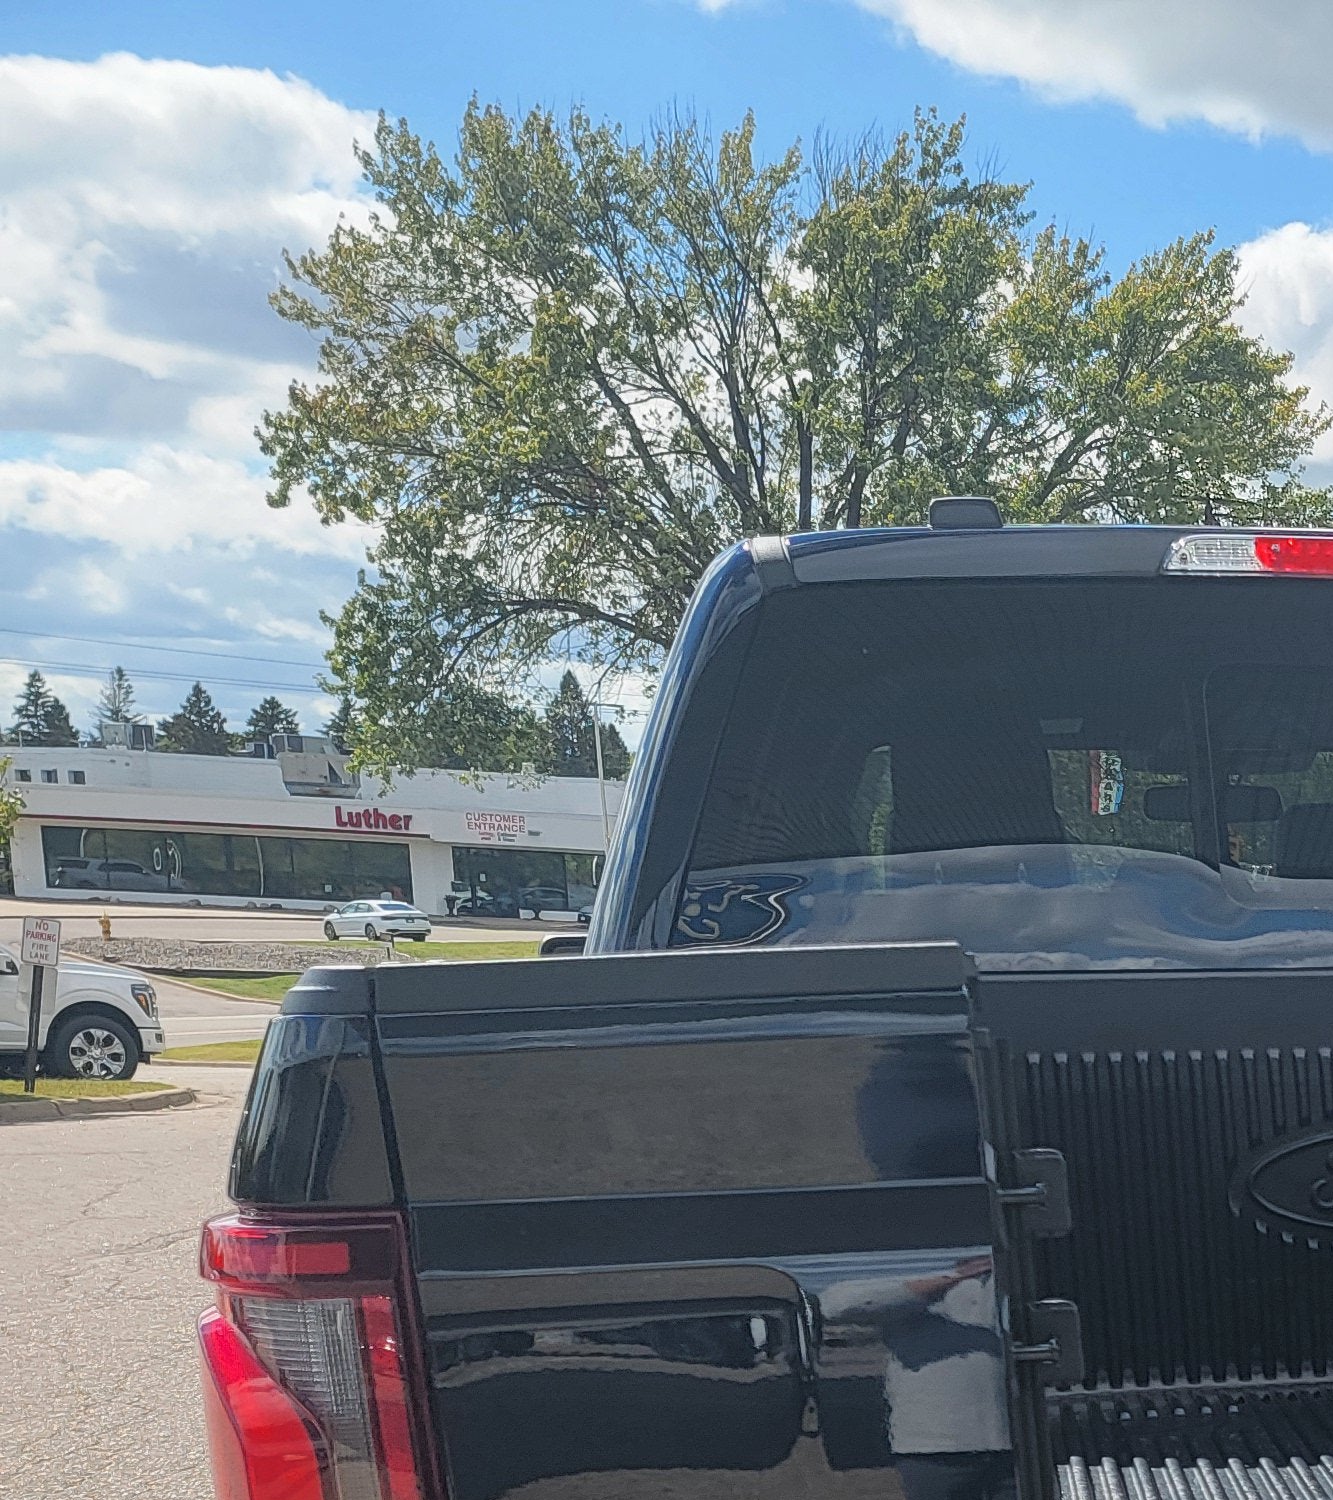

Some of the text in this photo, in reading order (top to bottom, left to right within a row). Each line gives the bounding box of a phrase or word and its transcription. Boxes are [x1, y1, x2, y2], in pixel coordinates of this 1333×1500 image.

[334, 805, 413, 831] Luther
[465, 812, 526, 825] CUSTOMER
[467, 821, 526, 833] ENTRANCE
[35, 921, 49, 931] NO
[29, 951, 50, 960] LANE
